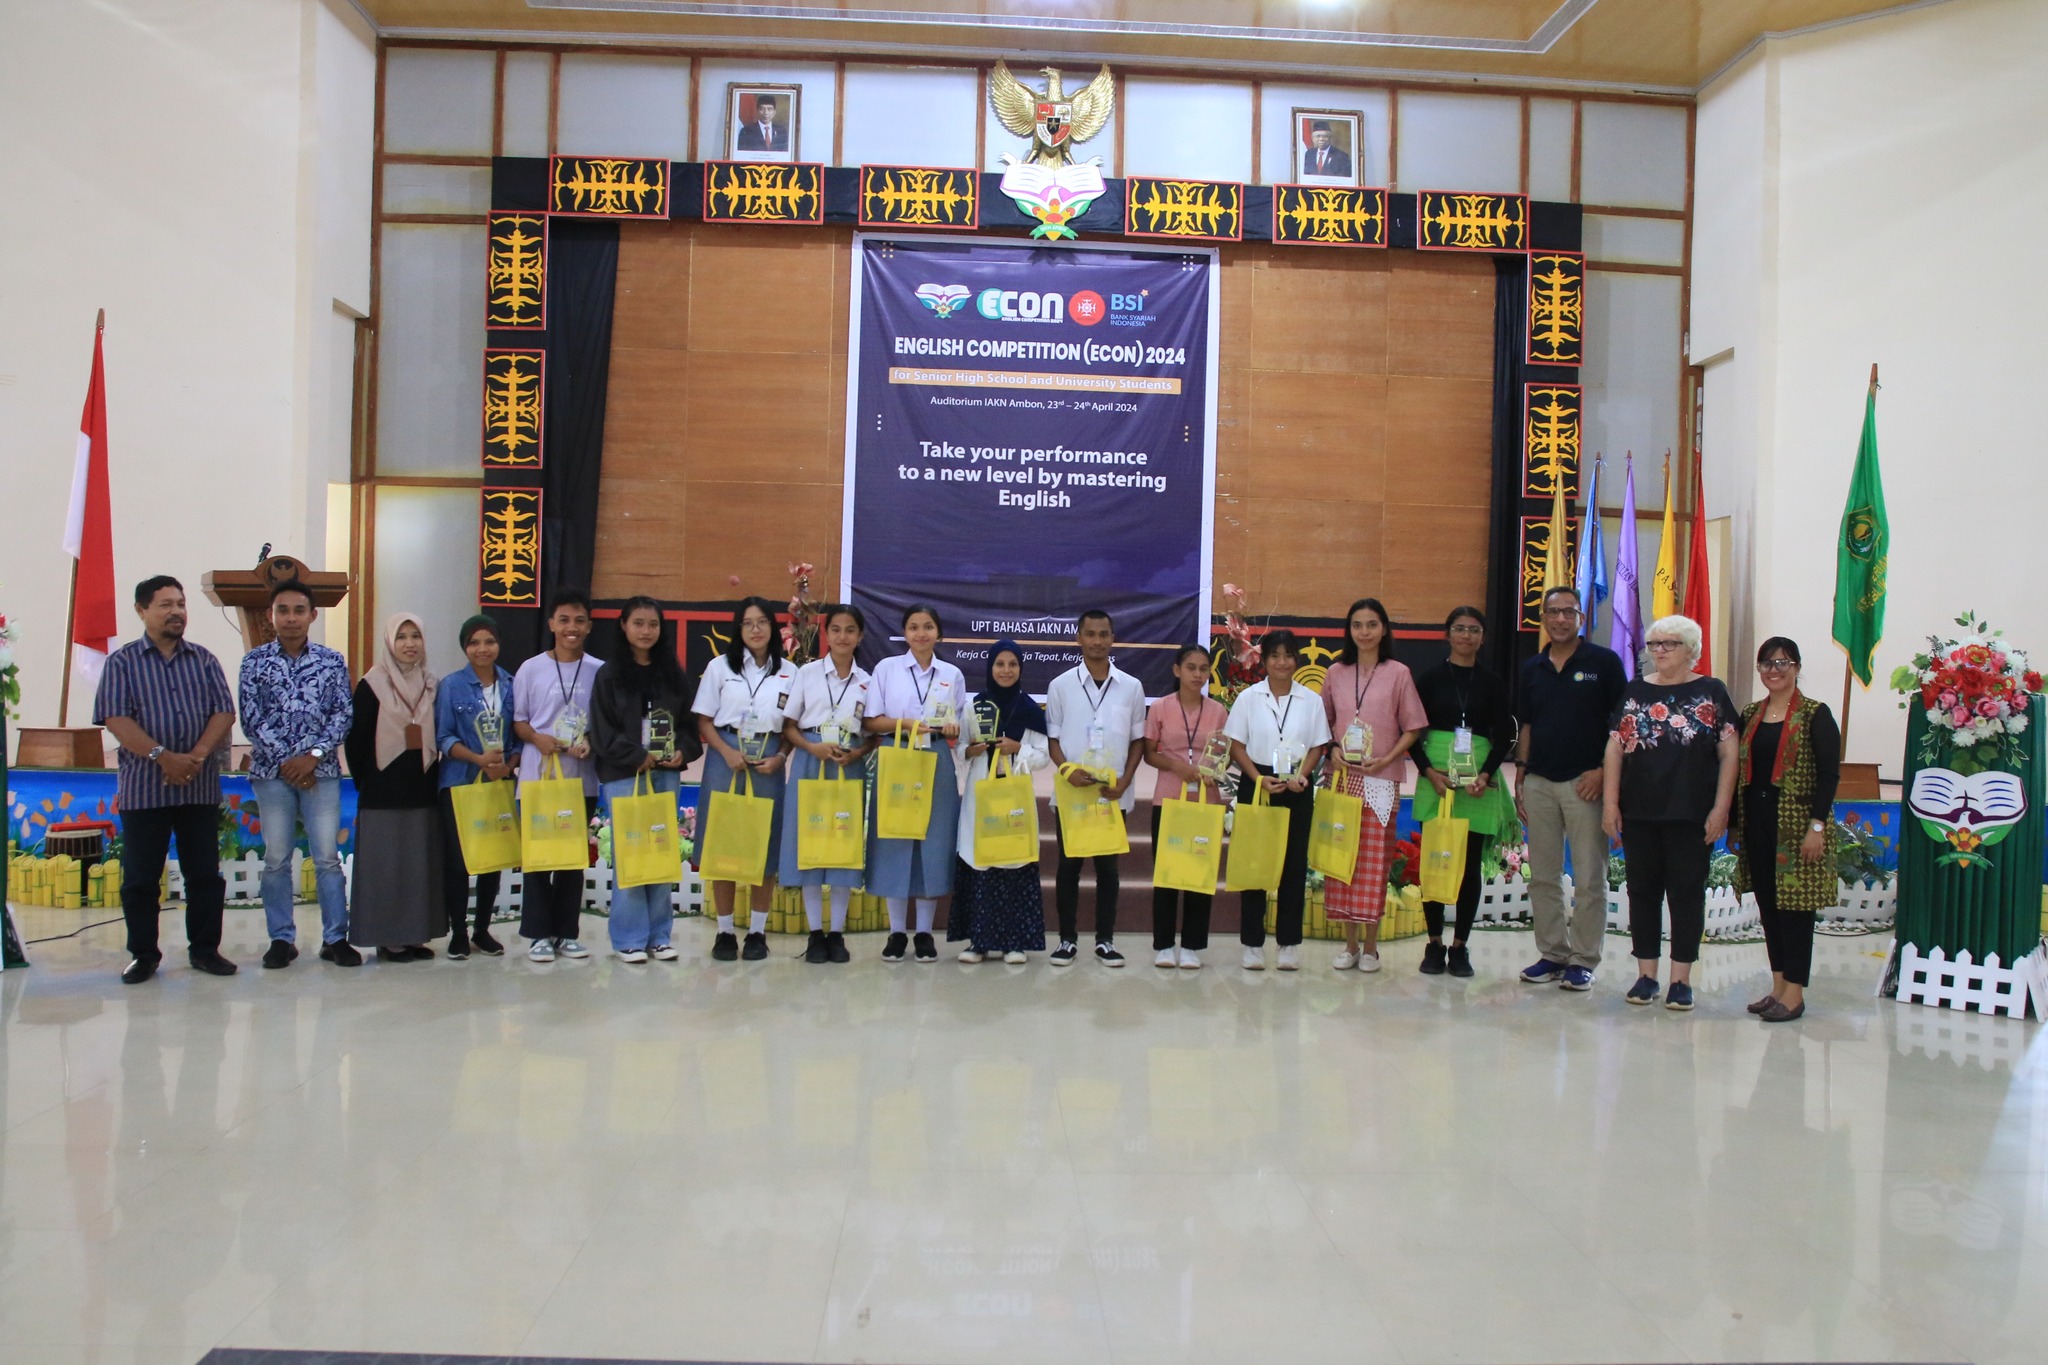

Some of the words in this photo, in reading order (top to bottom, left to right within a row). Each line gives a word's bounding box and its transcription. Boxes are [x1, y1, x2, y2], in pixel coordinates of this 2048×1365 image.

[1110, 293, 1143, 311] BSI
[895, 337, 963, 356] ENGLISH
[966, 340, 1080, 360] COMPETITION
[1083, 338, 1144, 367] (ECON)
[1145, 346, 1186, 365] 2024
[894, 369, 911, 380] for
[914, 370, 953, 381] Senior
[955, 372, 984, 385] High
[987, 373, 1027, 385] School
[1030, 375, 1053, 385] and
[1056, 376, 1116, 390] University
[1119, 380, 1172, 391] Students
[930, 396, 982, 406] Auditorium
[984, 398, 1007, 407] IAKN
[1009, 399, 1046, 410] Ambon,
[1091, 402, 1114, 412] April
[1115, 403, 1138, 412] 2024
[919, 441, 966, 459] Take
[970, 447, 1016, 464] your
[1020, 445, 1148, 465] performance
[898, 464, 919, 480] to
[923, 467, 936, 480] a
[940, 468, 982, 482] new
[986, 465, 1033, 484] level
[1038, 467, 1063, 489] by
[1067, 470, 1167, 493] mastering
[998, 489, 1071, 511] English
[971, 620, 991, 632] UPT
[993, 621, 1035, 634] BAHASA
[1037, 622, 1061, 634] IAKN
[956, 650, 979, 661] Kerja
[1034, 651, 1061, 663] Tepat,
